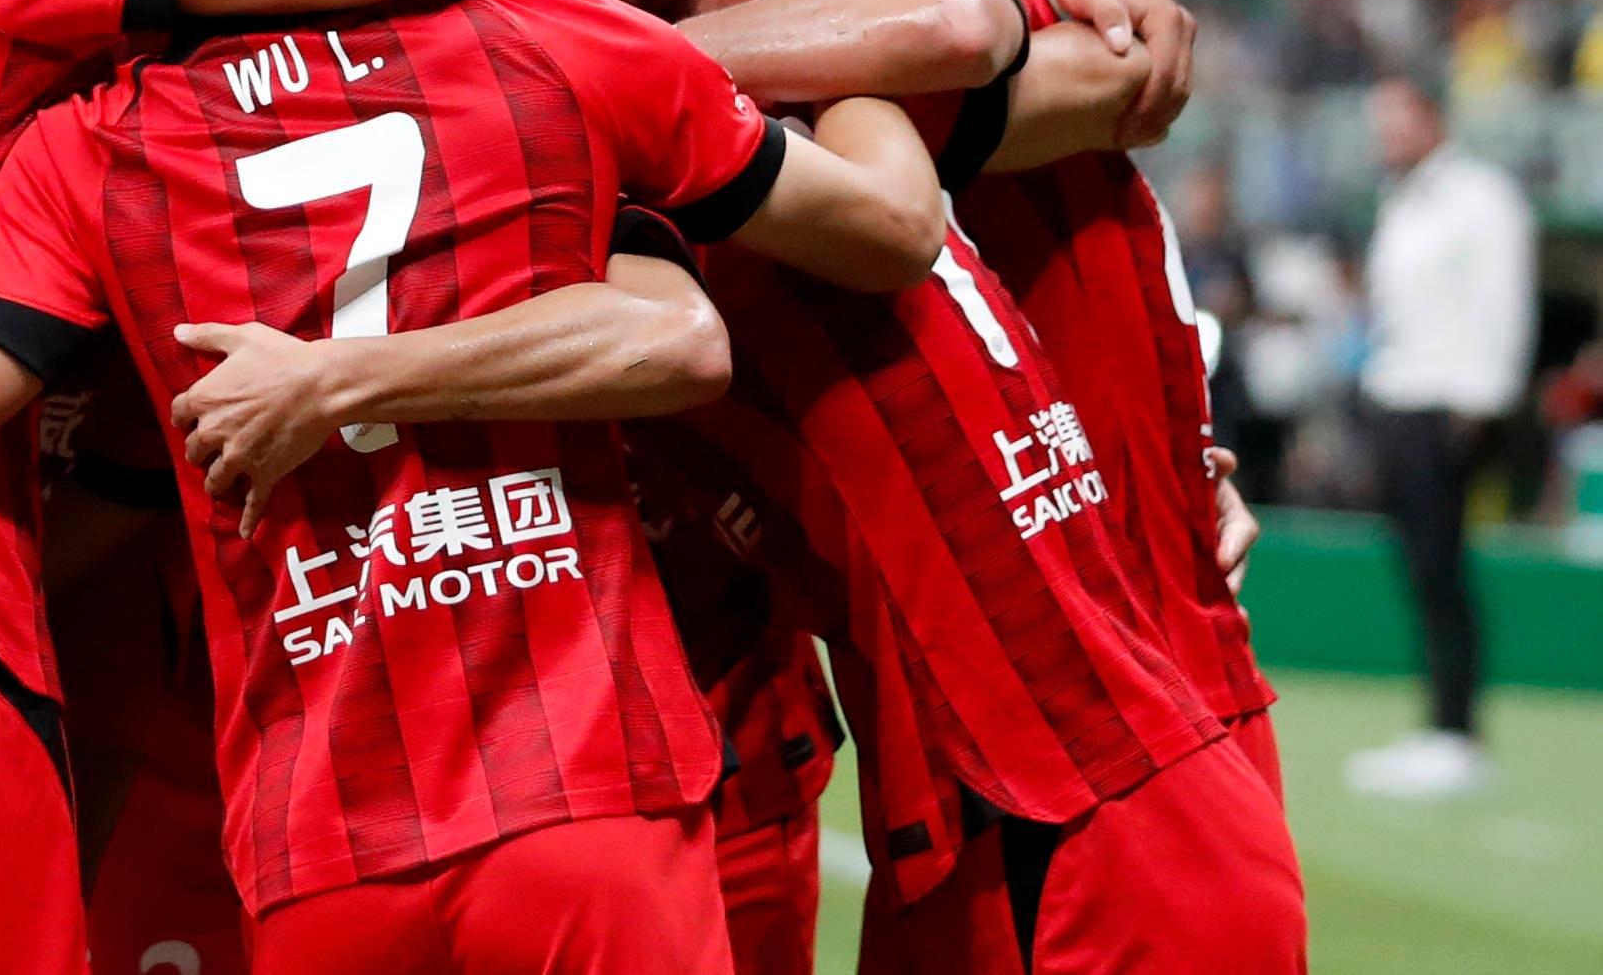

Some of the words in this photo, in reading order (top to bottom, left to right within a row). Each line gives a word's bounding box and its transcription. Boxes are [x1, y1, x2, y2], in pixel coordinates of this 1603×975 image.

[222, 34, 310, 114] WU
[327, 30, 385, 82] L.
[236, 111, 426, 454] 7
[273, 467, 573, 624] 上汽集团
[1012, 481, 1083, 541] SAIC
[379, 546, 584, 618] MOTOR
